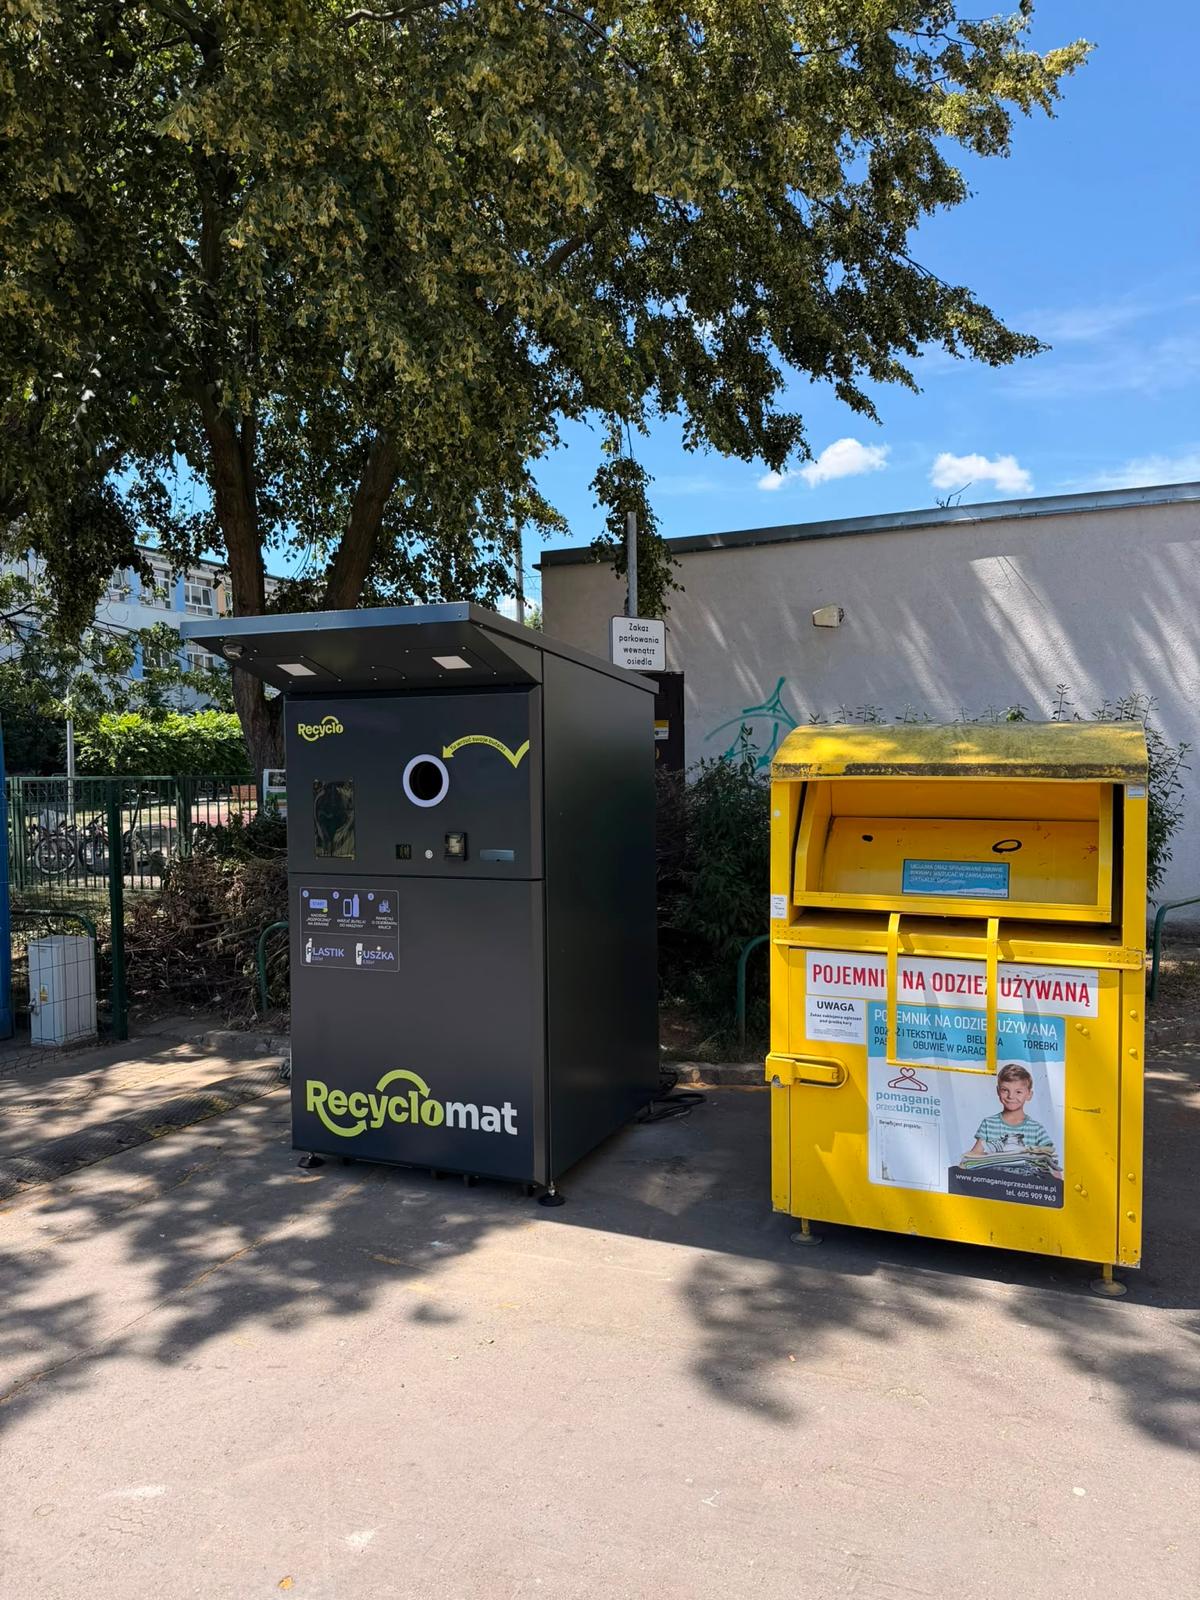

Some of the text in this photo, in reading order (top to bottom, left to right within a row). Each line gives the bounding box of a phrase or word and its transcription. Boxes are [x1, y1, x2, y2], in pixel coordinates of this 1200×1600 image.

[629, 622, 649, 632] Zakaz
[619, 635, 659, 644] parkowania
[298, 720, 344, 741] Recyclo
[307, 947, 344, 957] PLASTIK
[357, 950, 395, 960] PUSZKA
[812, 964, 1091, 1007] POJEMNI NA ODZIE UŻYWANĄ
[816, 1001, 855, 1012] UWAGA
[874, 1009, 1057, 1040] POEMNIK NA ODZIE UŻYWANĄ
[906, 1029, 948, 1041] TEKSTYLIA
[966, 1034, 1004, 1047] BIELIA
[1023, 1039, 1058, 1051] TOREBKI
[913, 1040, 944, 1051] OBUWIE
[946, 1044, 955, 1052] W
[876, 1091, 941, 1106] pomaganie
[306, 1076, 518, 1137] Recyclomat
[955, 1174, 1057, 1193] www.pomaganieprzezubranie.pl
[1043, 1194, 1056, 1202] 963
